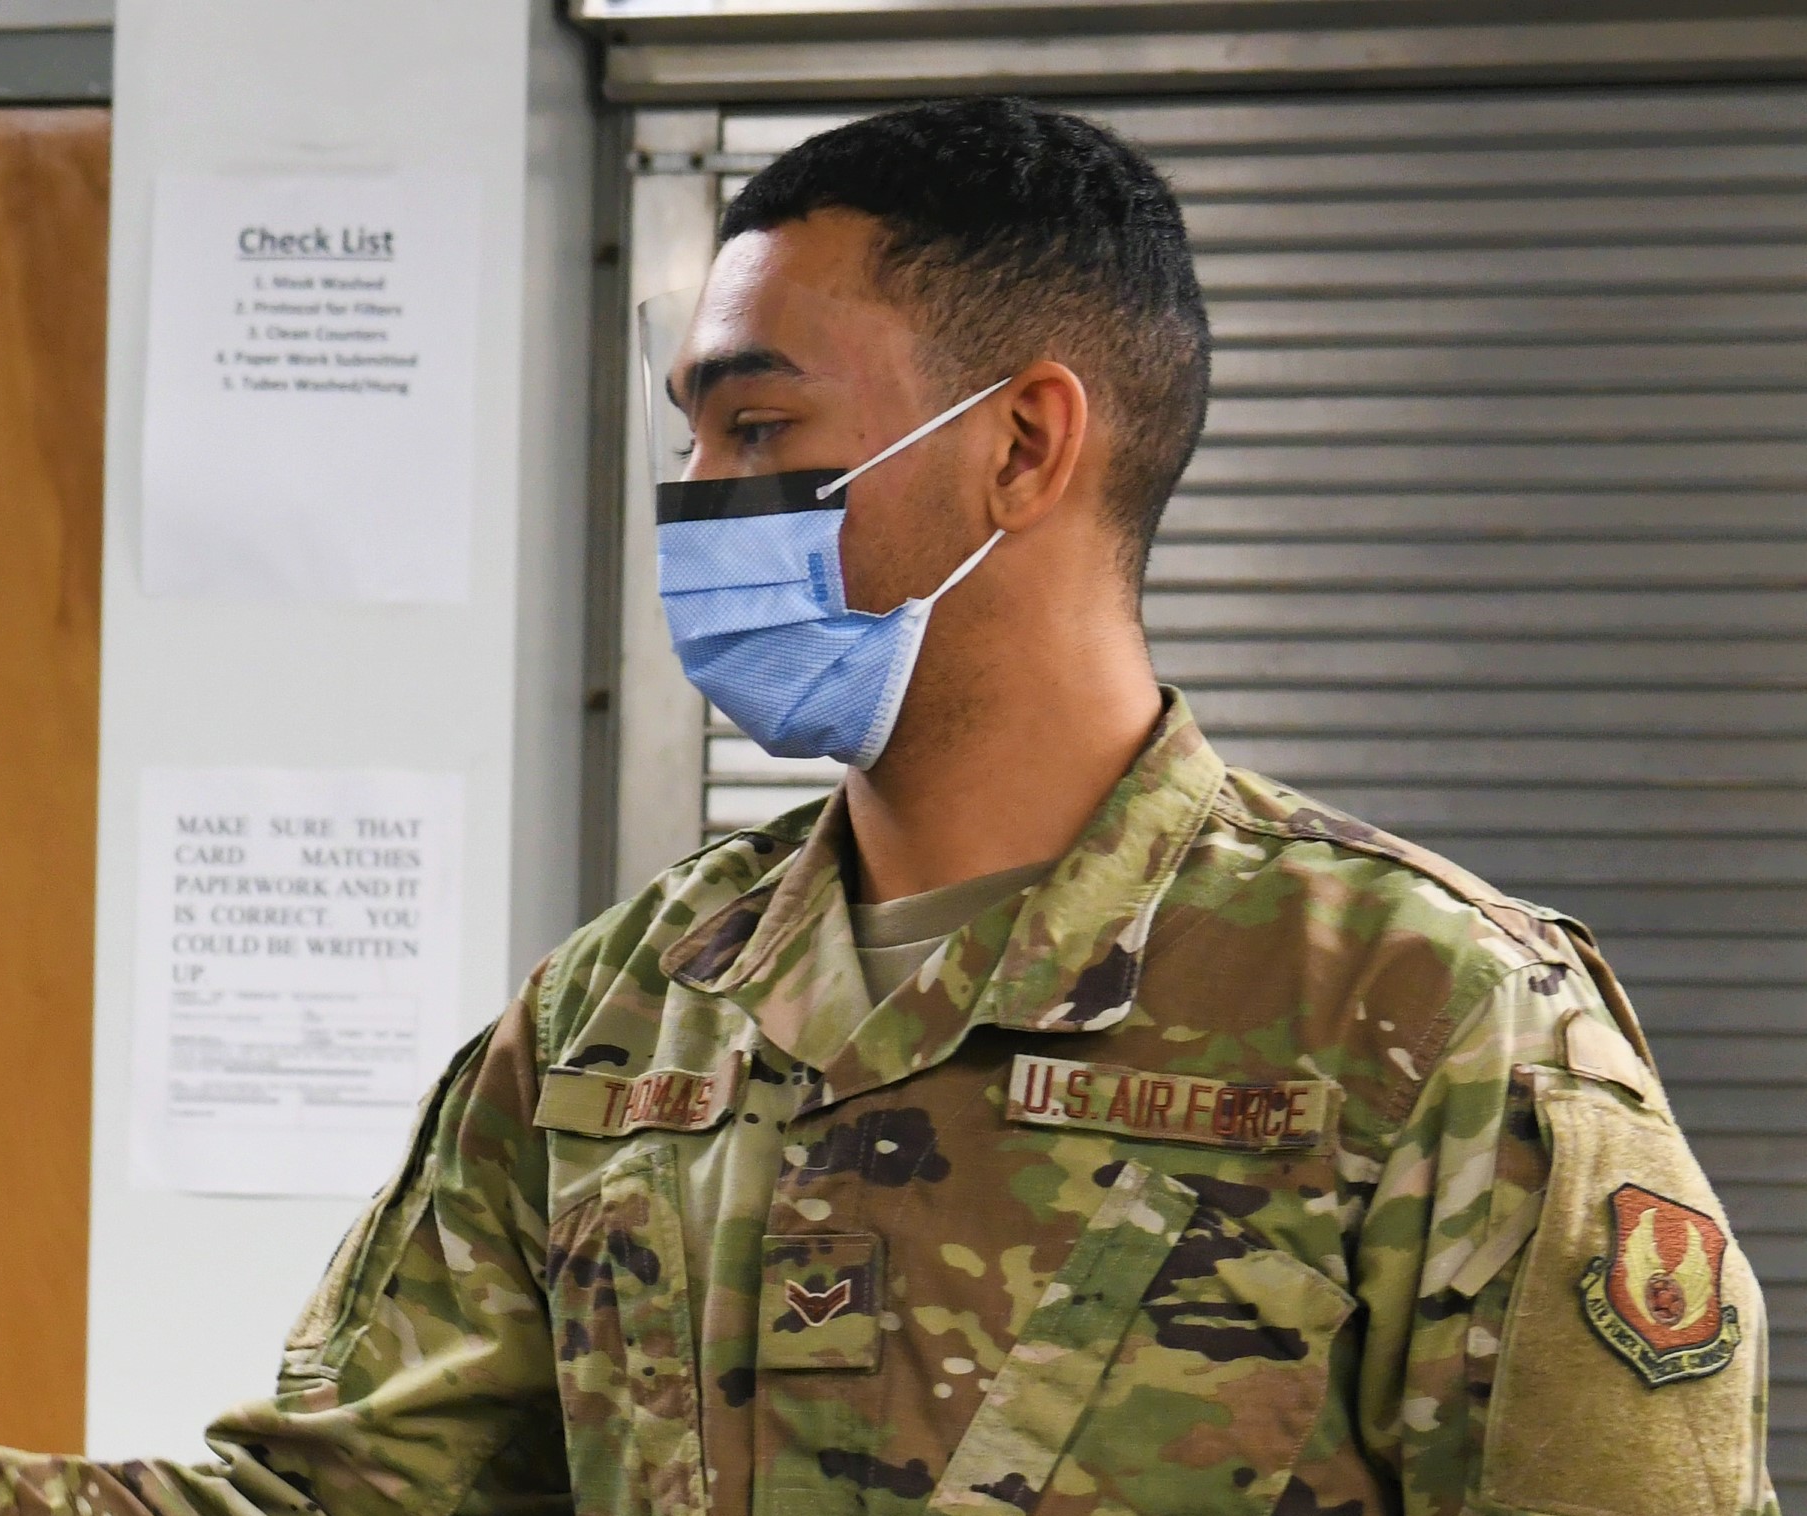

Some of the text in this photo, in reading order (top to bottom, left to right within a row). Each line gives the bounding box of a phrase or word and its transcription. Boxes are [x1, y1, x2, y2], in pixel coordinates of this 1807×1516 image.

[239, 228, 394, 254] Check List
[176, 815, 422, 840] MAKE SURE THAT
[175, 844, 422, 870] CARD MATCHES
[174, 875, 420, 899] PAPERWORK AND IT
[174, 904, 197, 925] IS
[366, 907, 420, 930] YOU
[171, 933, 419, 959] COULD BE WRITTEN
[1024, 1063, 1308, 1138] U.S. AIR FORCE
